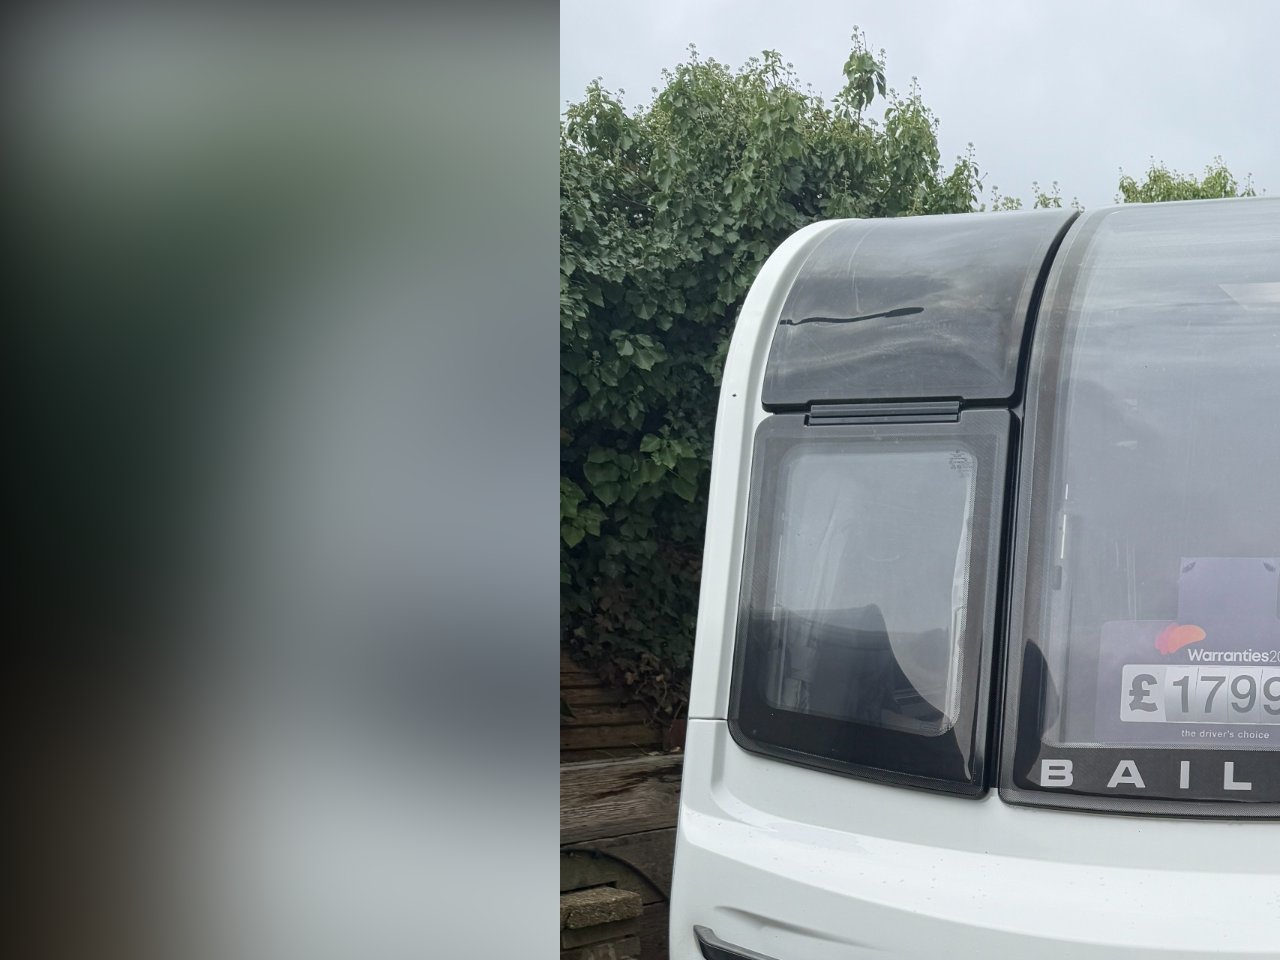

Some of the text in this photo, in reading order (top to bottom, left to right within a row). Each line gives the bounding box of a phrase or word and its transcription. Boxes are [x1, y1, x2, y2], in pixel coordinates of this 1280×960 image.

[1181, 729, 1270, 739] the driver's choice
